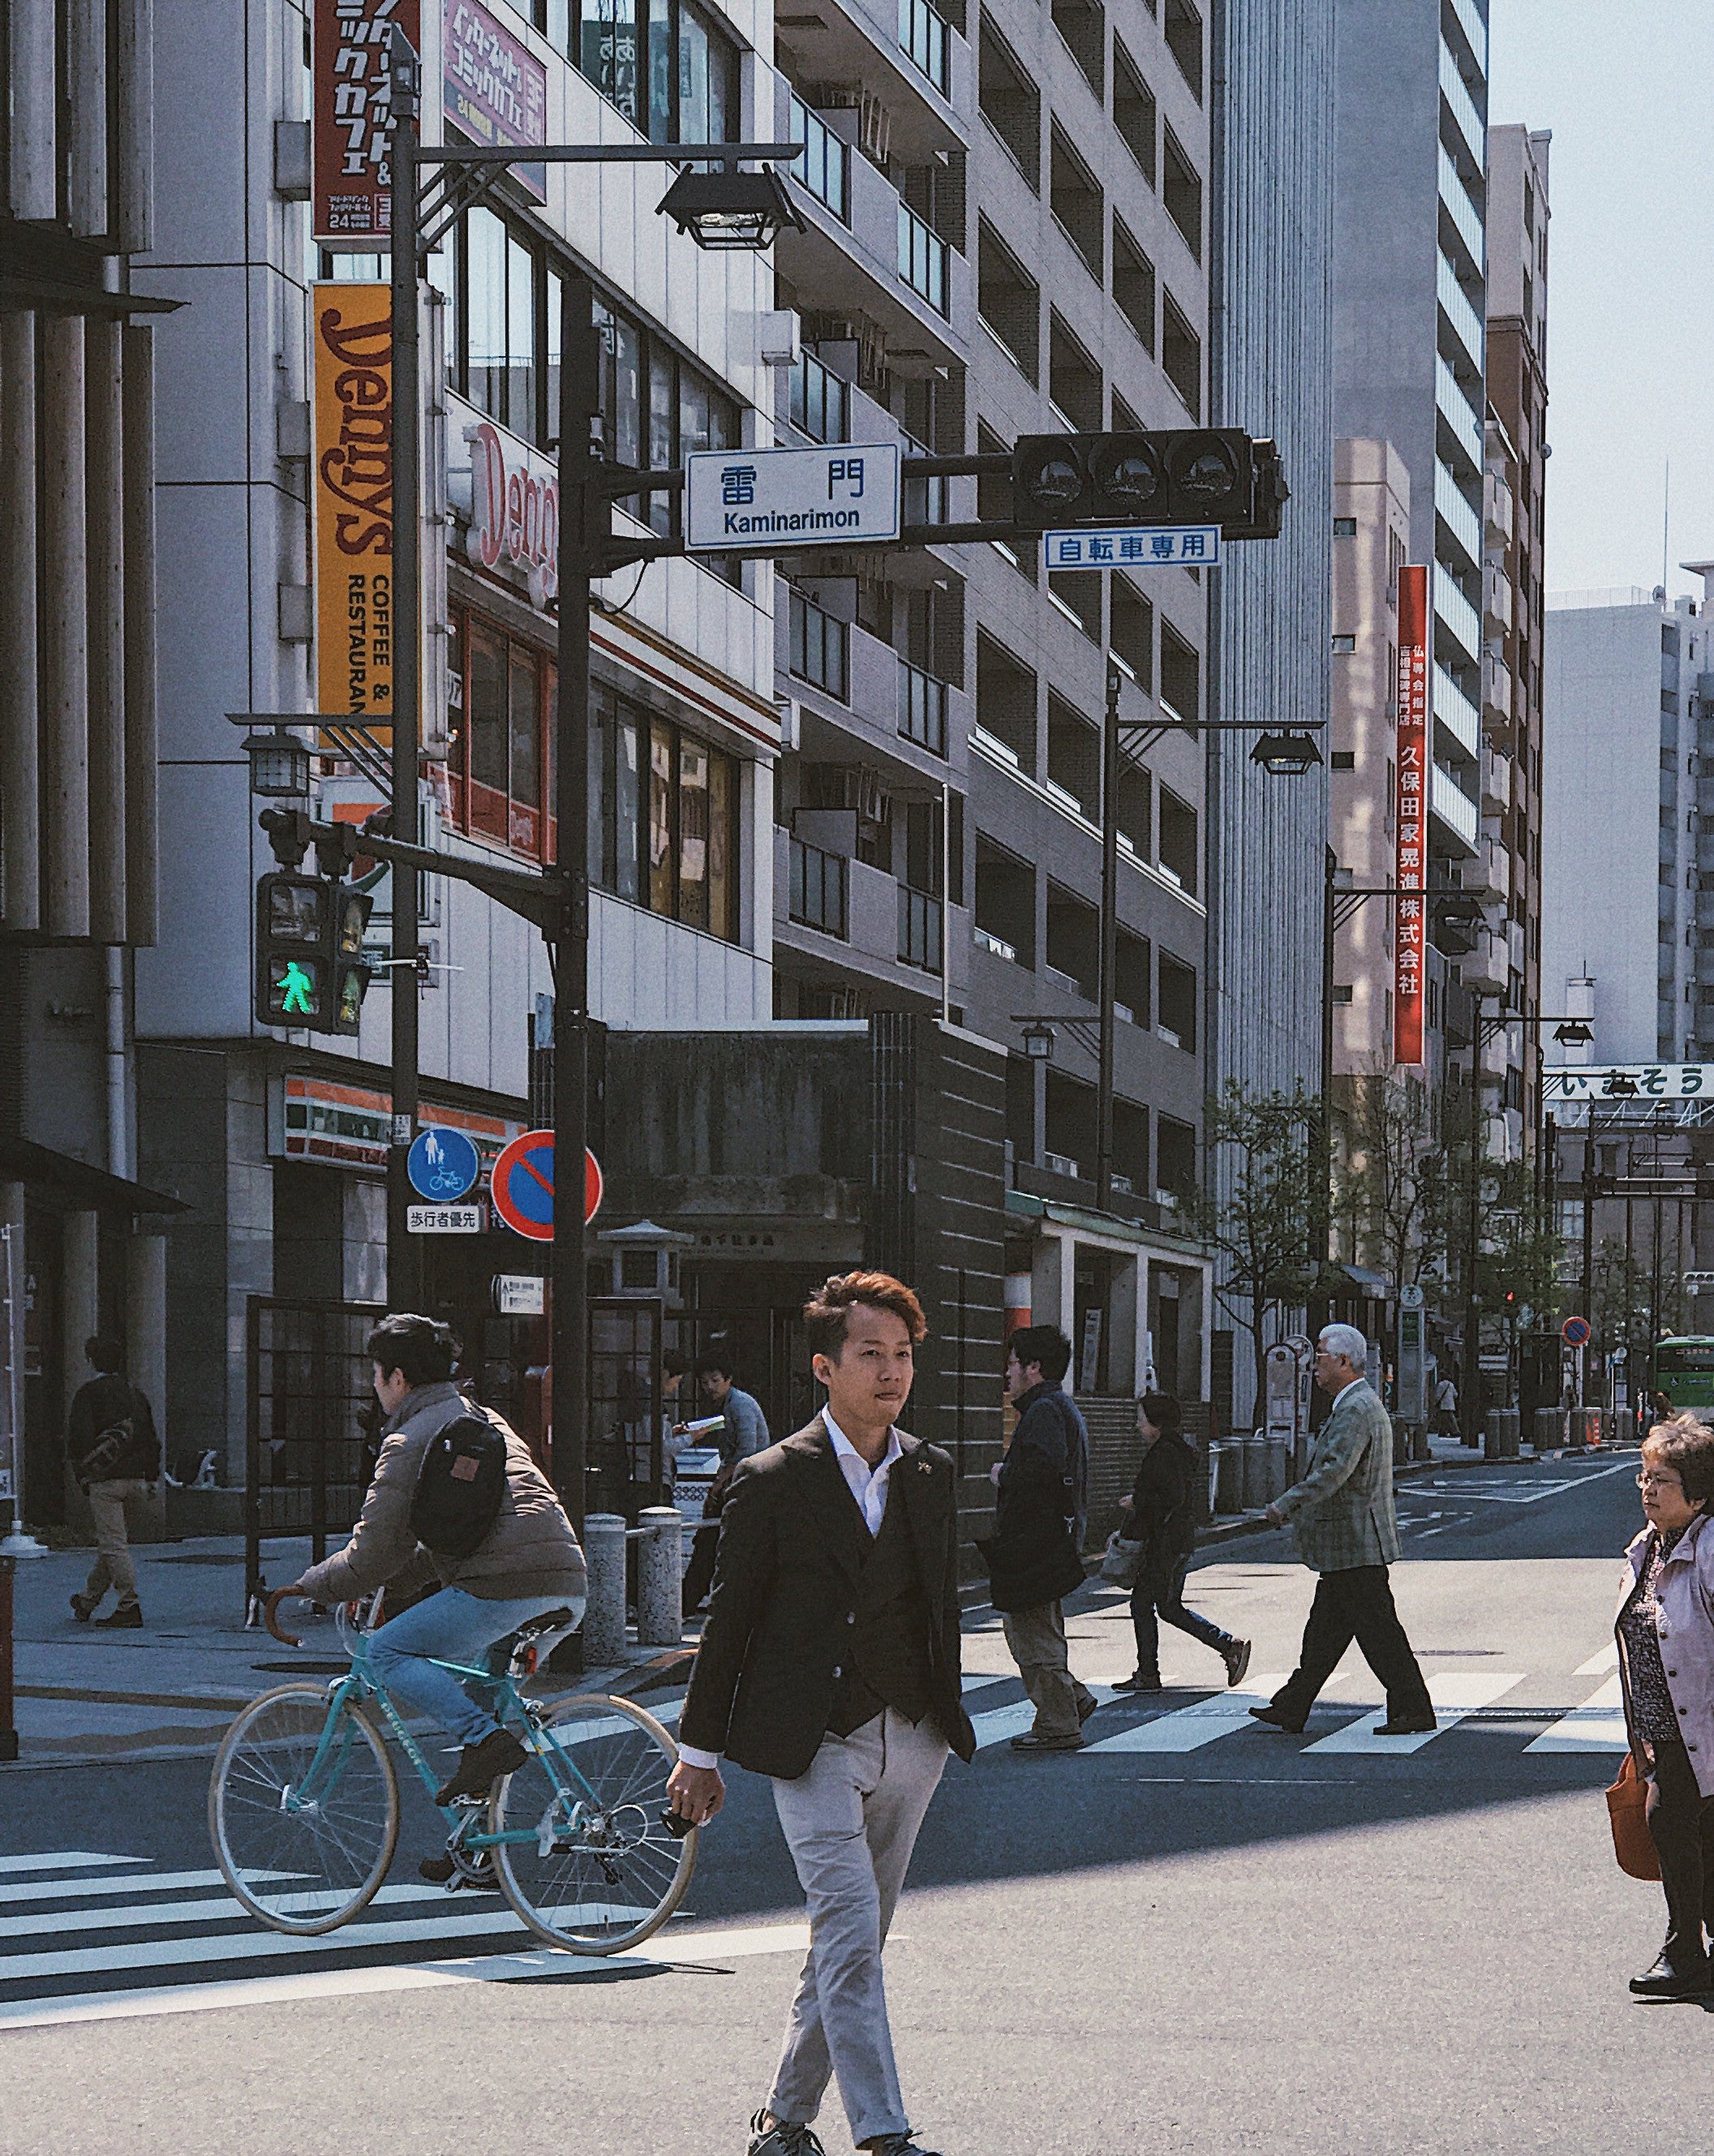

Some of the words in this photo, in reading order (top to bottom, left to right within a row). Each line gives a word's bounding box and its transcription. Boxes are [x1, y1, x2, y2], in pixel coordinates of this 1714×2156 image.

[721, 458, 865, 505] 雷門
[724, 508, 860, 535] Kaminarimon
[1059, 534, 1205, 561] 自転車専用
[372, 574, 390, 666] COFFEE
[373, 683, 390, 702] &
[410, 1211, 476, 1228] 歩行者優先
